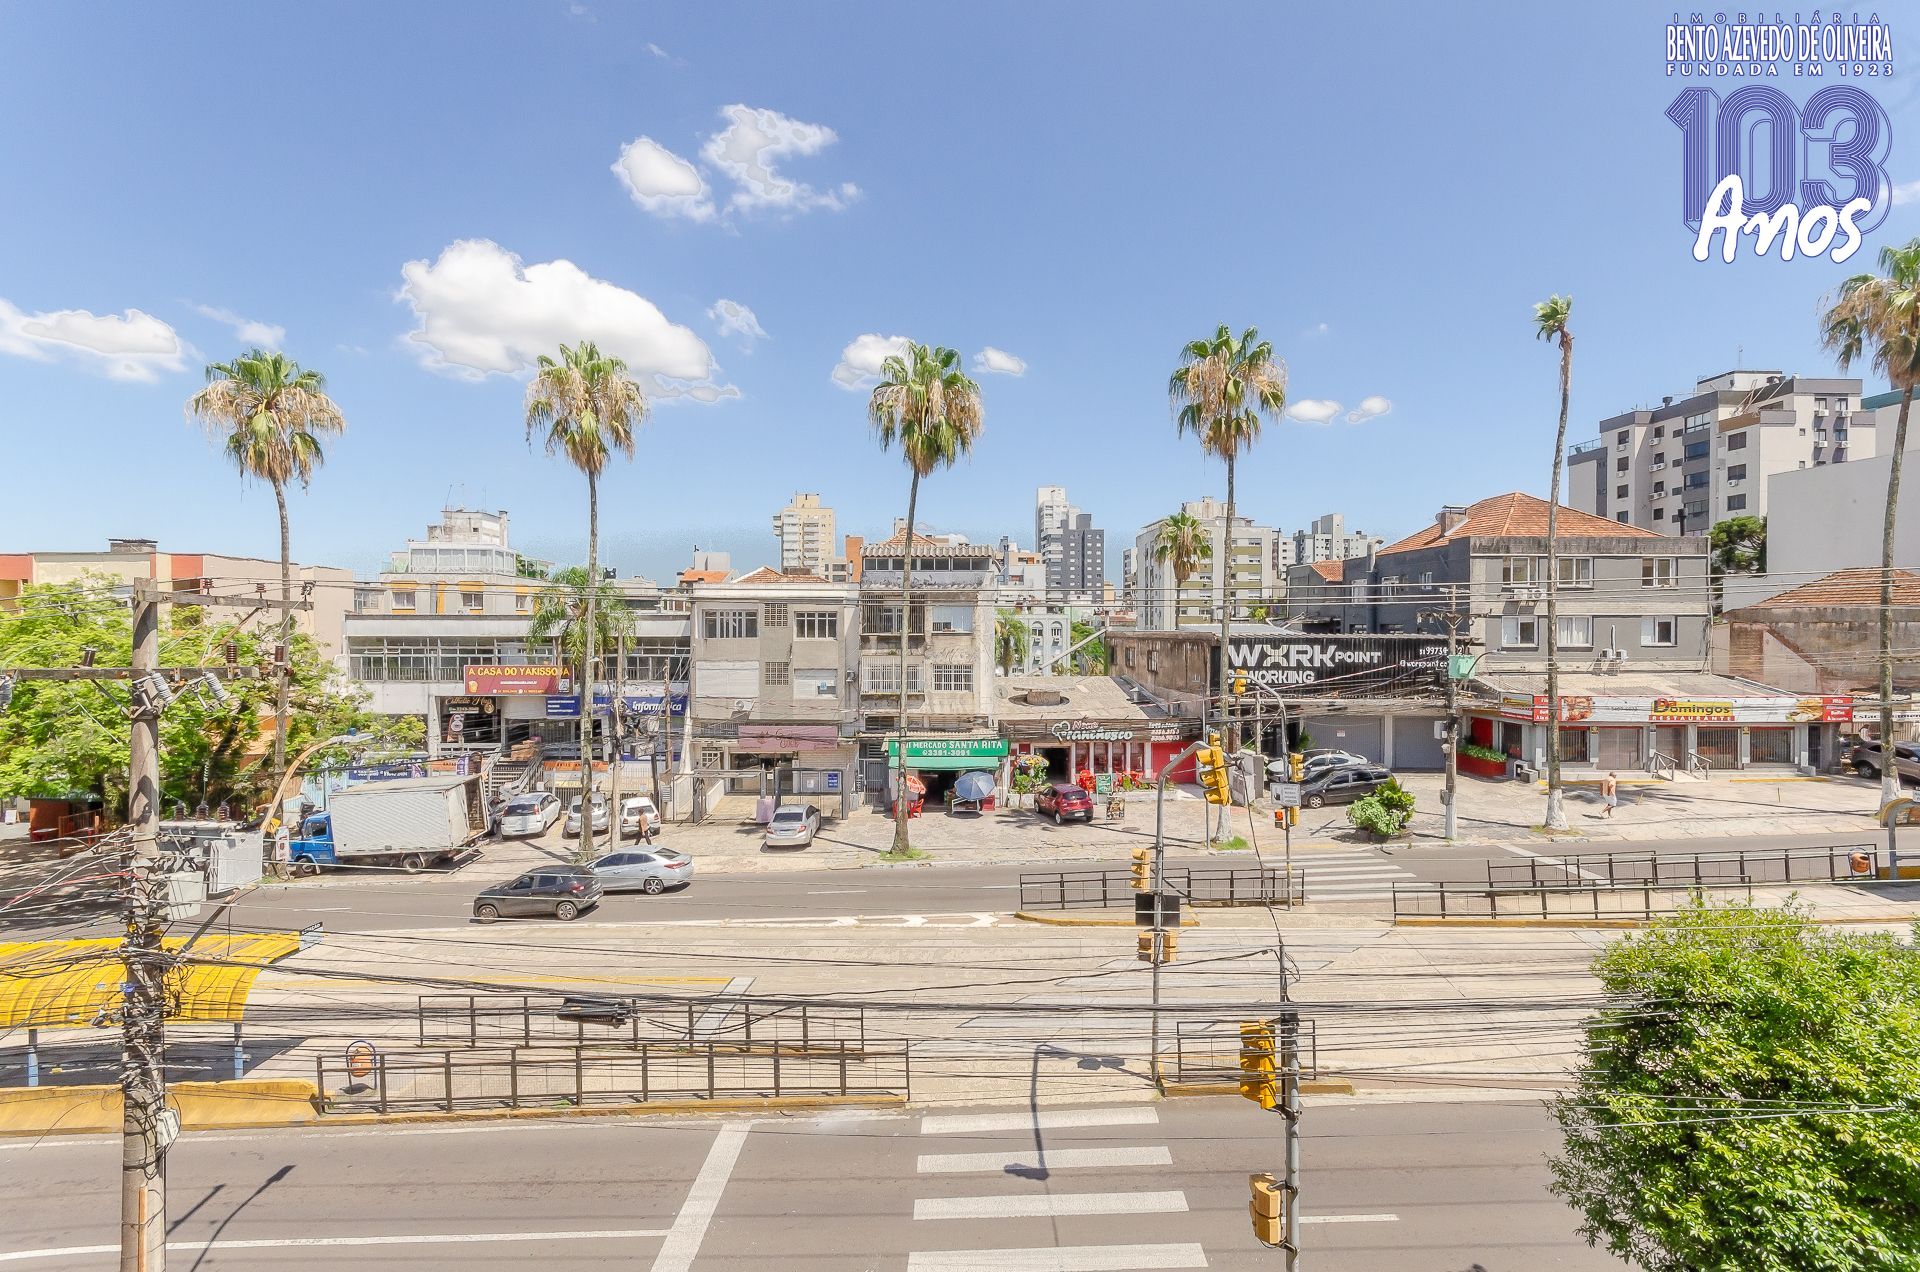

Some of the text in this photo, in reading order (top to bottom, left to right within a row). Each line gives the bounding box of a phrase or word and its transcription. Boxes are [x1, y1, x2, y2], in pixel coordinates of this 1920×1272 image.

[1335, 651, 1382, 663] POINT
[468, 667, 475, 676] A
[478, 667, 502, 676] CASA
[504, 667, 517, 676] DO
[1228, 670, 1314, 684] CWORKING
[1654, 700, 1730, 715] Domingos
[912, 741, 947, 749] MERCADO
[949, 740, 979, 749] SANTA
[981, 740, 1003, 749] RITA
